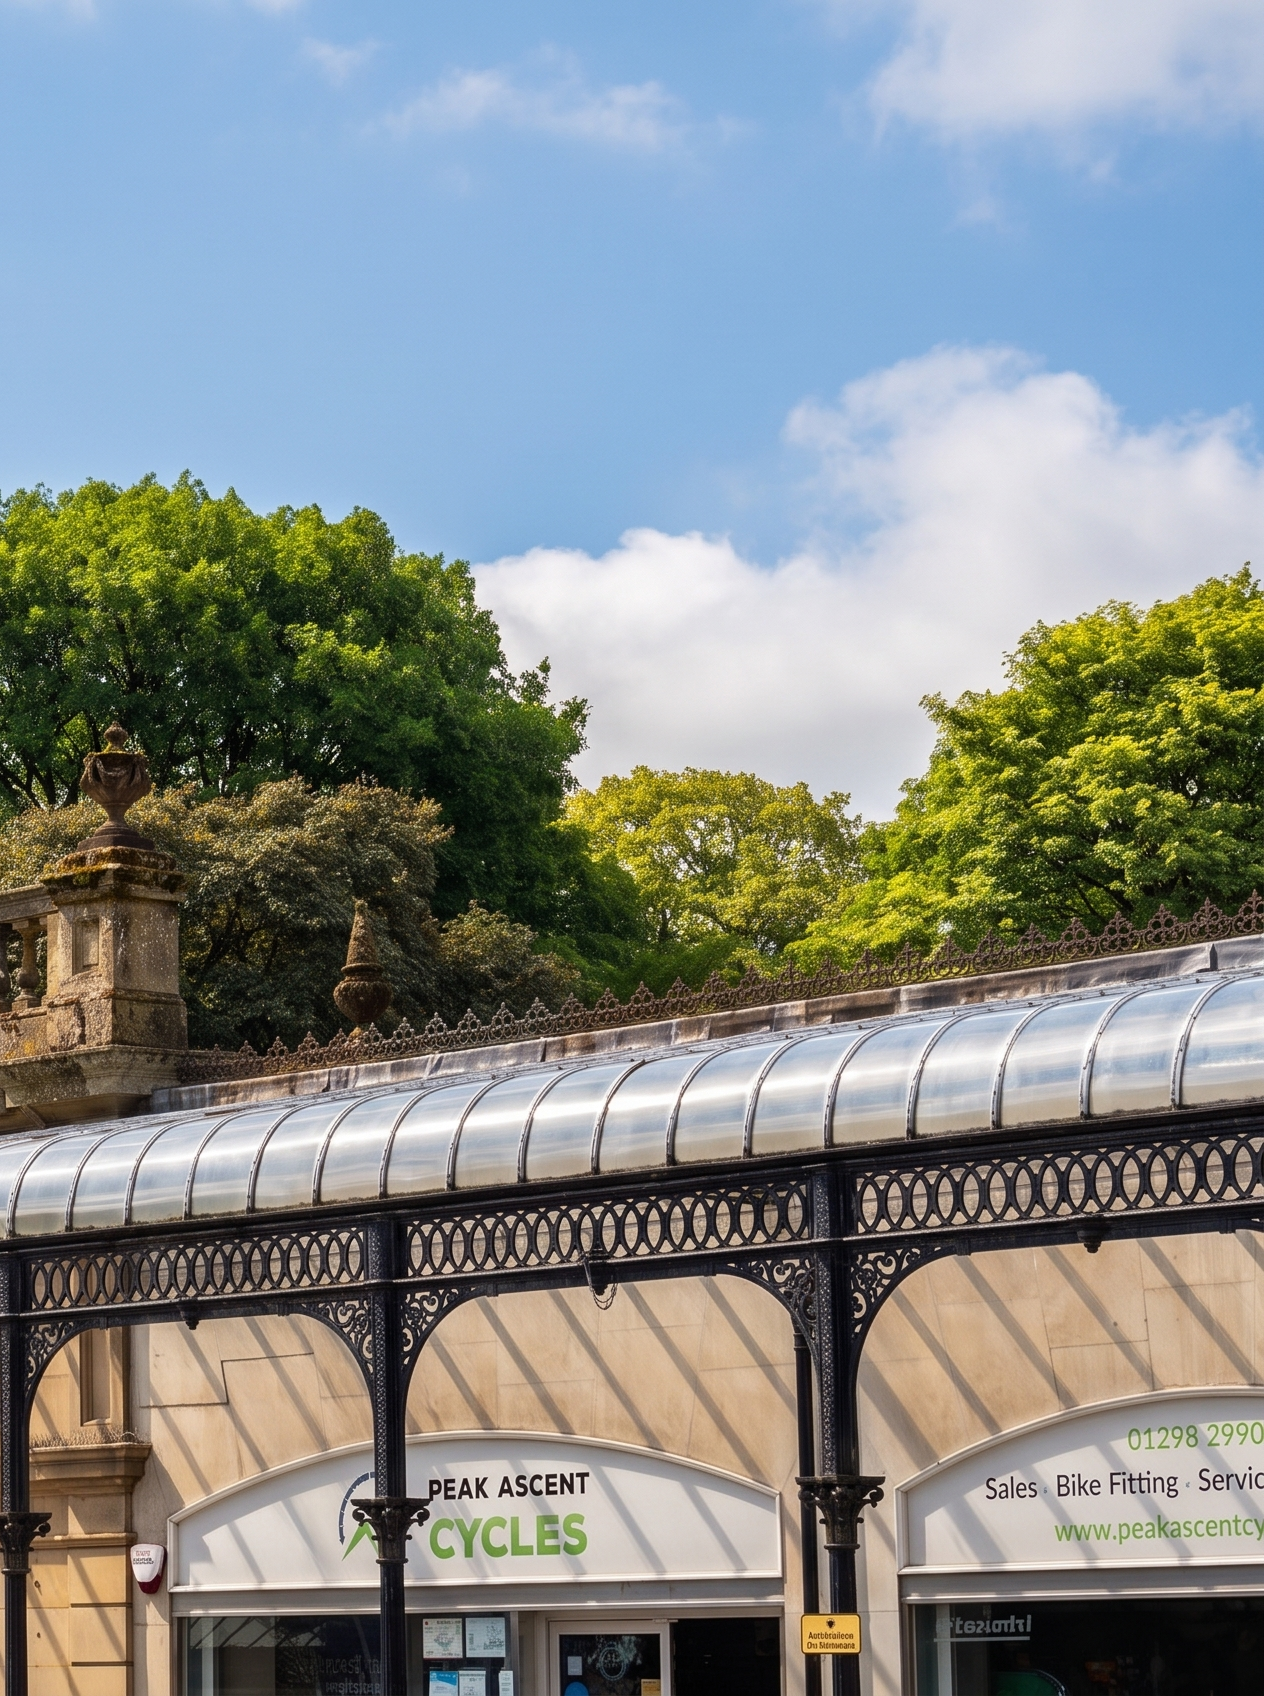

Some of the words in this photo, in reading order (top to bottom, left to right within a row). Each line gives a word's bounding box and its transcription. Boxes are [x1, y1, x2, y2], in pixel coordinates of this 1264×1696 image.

[1127, 1424, 1199, 1451] 01298
[1207, 1421, 1264, 1447] 2990
[428, 1476, 489, 1501] PEAK
[497, 1471, 590, 1498] ASCENT
[985, 1476, 1038, 1500] Sales
[1056, 1473, 1102, 1497] Bike
[1109, 1470, 1179, 1498] Fitting
[1198, 1466, 1264, 1492] Servic
[429, 1512, 588, 1560] CYCLES
